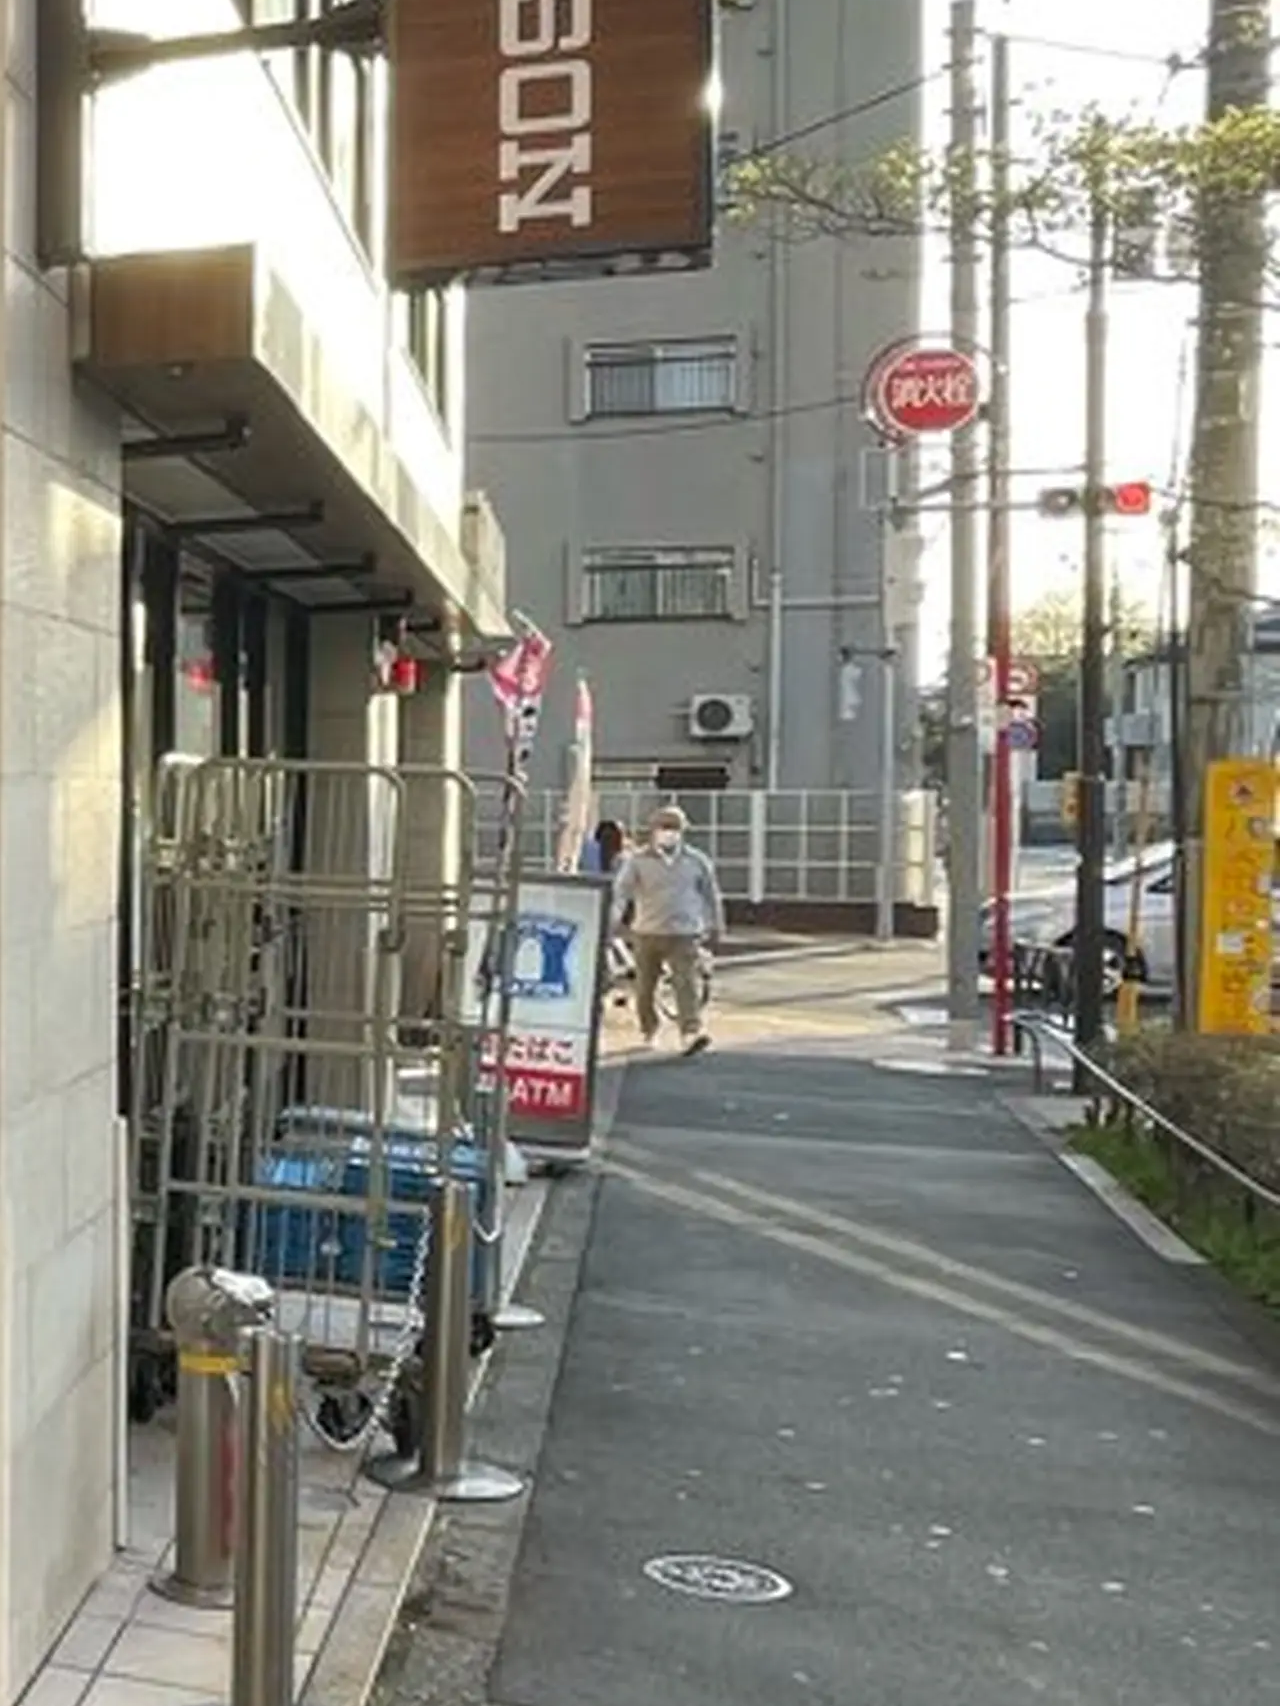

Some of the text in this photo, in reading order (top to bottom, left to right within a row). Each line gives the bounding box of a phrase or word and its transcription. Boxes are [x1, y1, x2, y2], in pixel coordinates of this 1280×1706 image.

[892, 373, 974, 409] 消火栓
[512, 1076, 573, 1107] ATM
